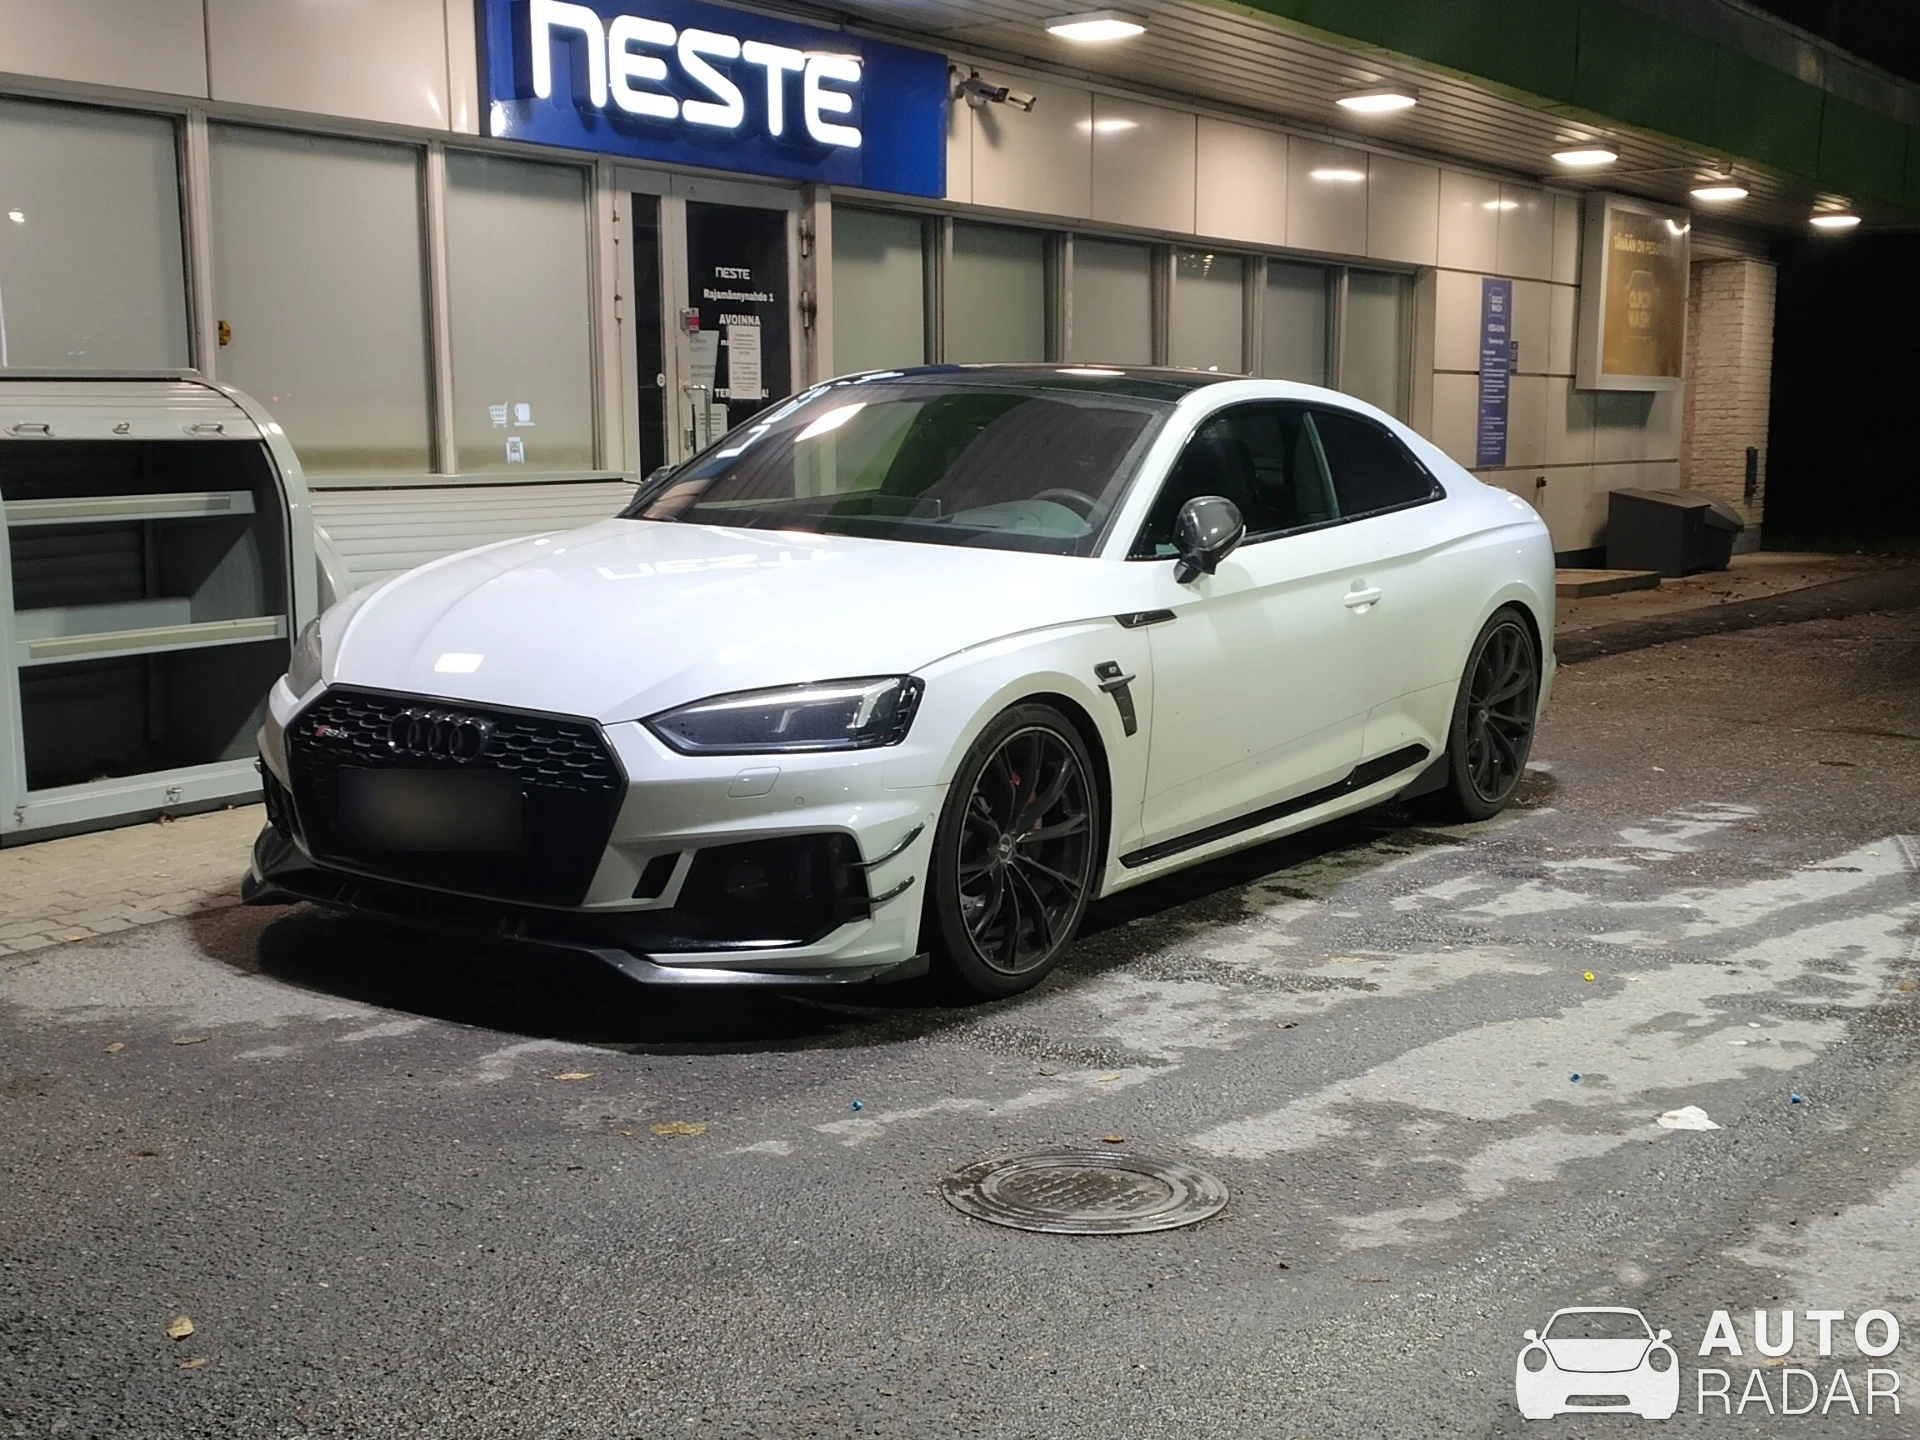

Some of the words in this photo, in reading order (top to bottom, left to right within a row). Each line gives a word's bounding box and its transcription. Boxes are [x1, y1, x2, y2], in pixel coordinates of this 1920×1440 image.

[530, 0, 862, 148] NESTE
[715, 266, 751, 280] NESTE
[769, 293, 774, 303] 1
[719, 313, 761, 326] AVOINNA
